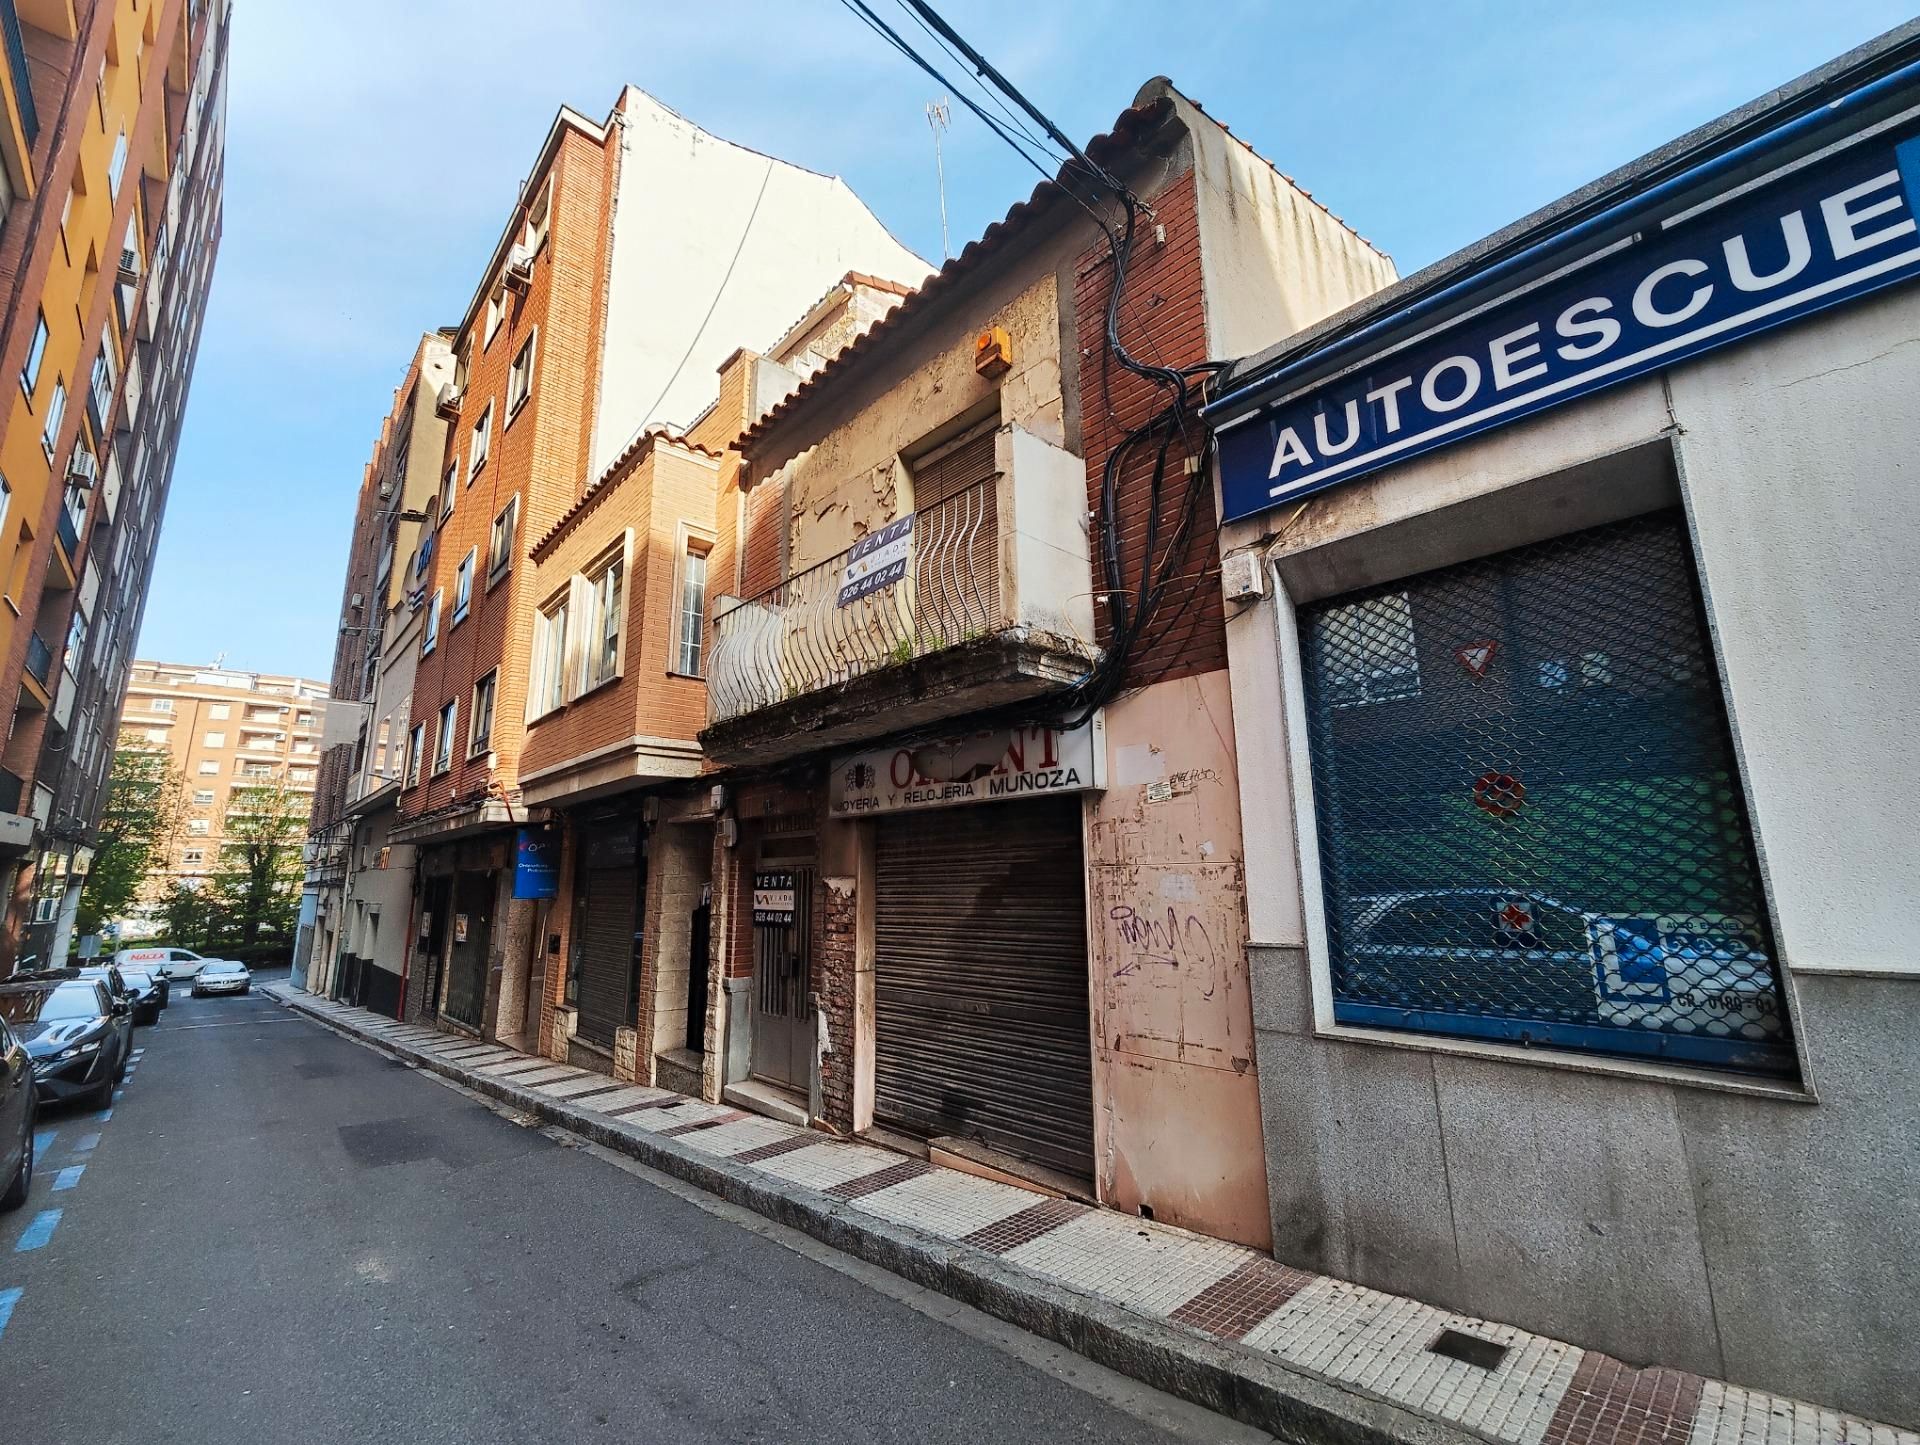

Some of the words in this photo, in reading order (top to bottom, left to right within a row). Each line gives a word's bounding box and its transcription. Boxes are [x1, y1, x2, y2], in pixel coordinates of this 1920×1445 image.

[1268, 168, 1918, 480] AUTOESCUE
[852, 518, 910, 560] VENTA
[842, 583, 859, 600] 926
[860, 577, 872, 591] 44
[874, 570, 887, 584] 02
[888, 561, 903, 577] 44
[887, 795, 897, 806] Y
[904, 784, 974, 804] RELOJERIA
[990, 768, 1080, 795] MUÑOZA
[756, 875, 792, 887] VENTA
[755, 912, 765, 922] 926
[767, 912, 774, 922] 44
[784, 912, 792, 923] 44
